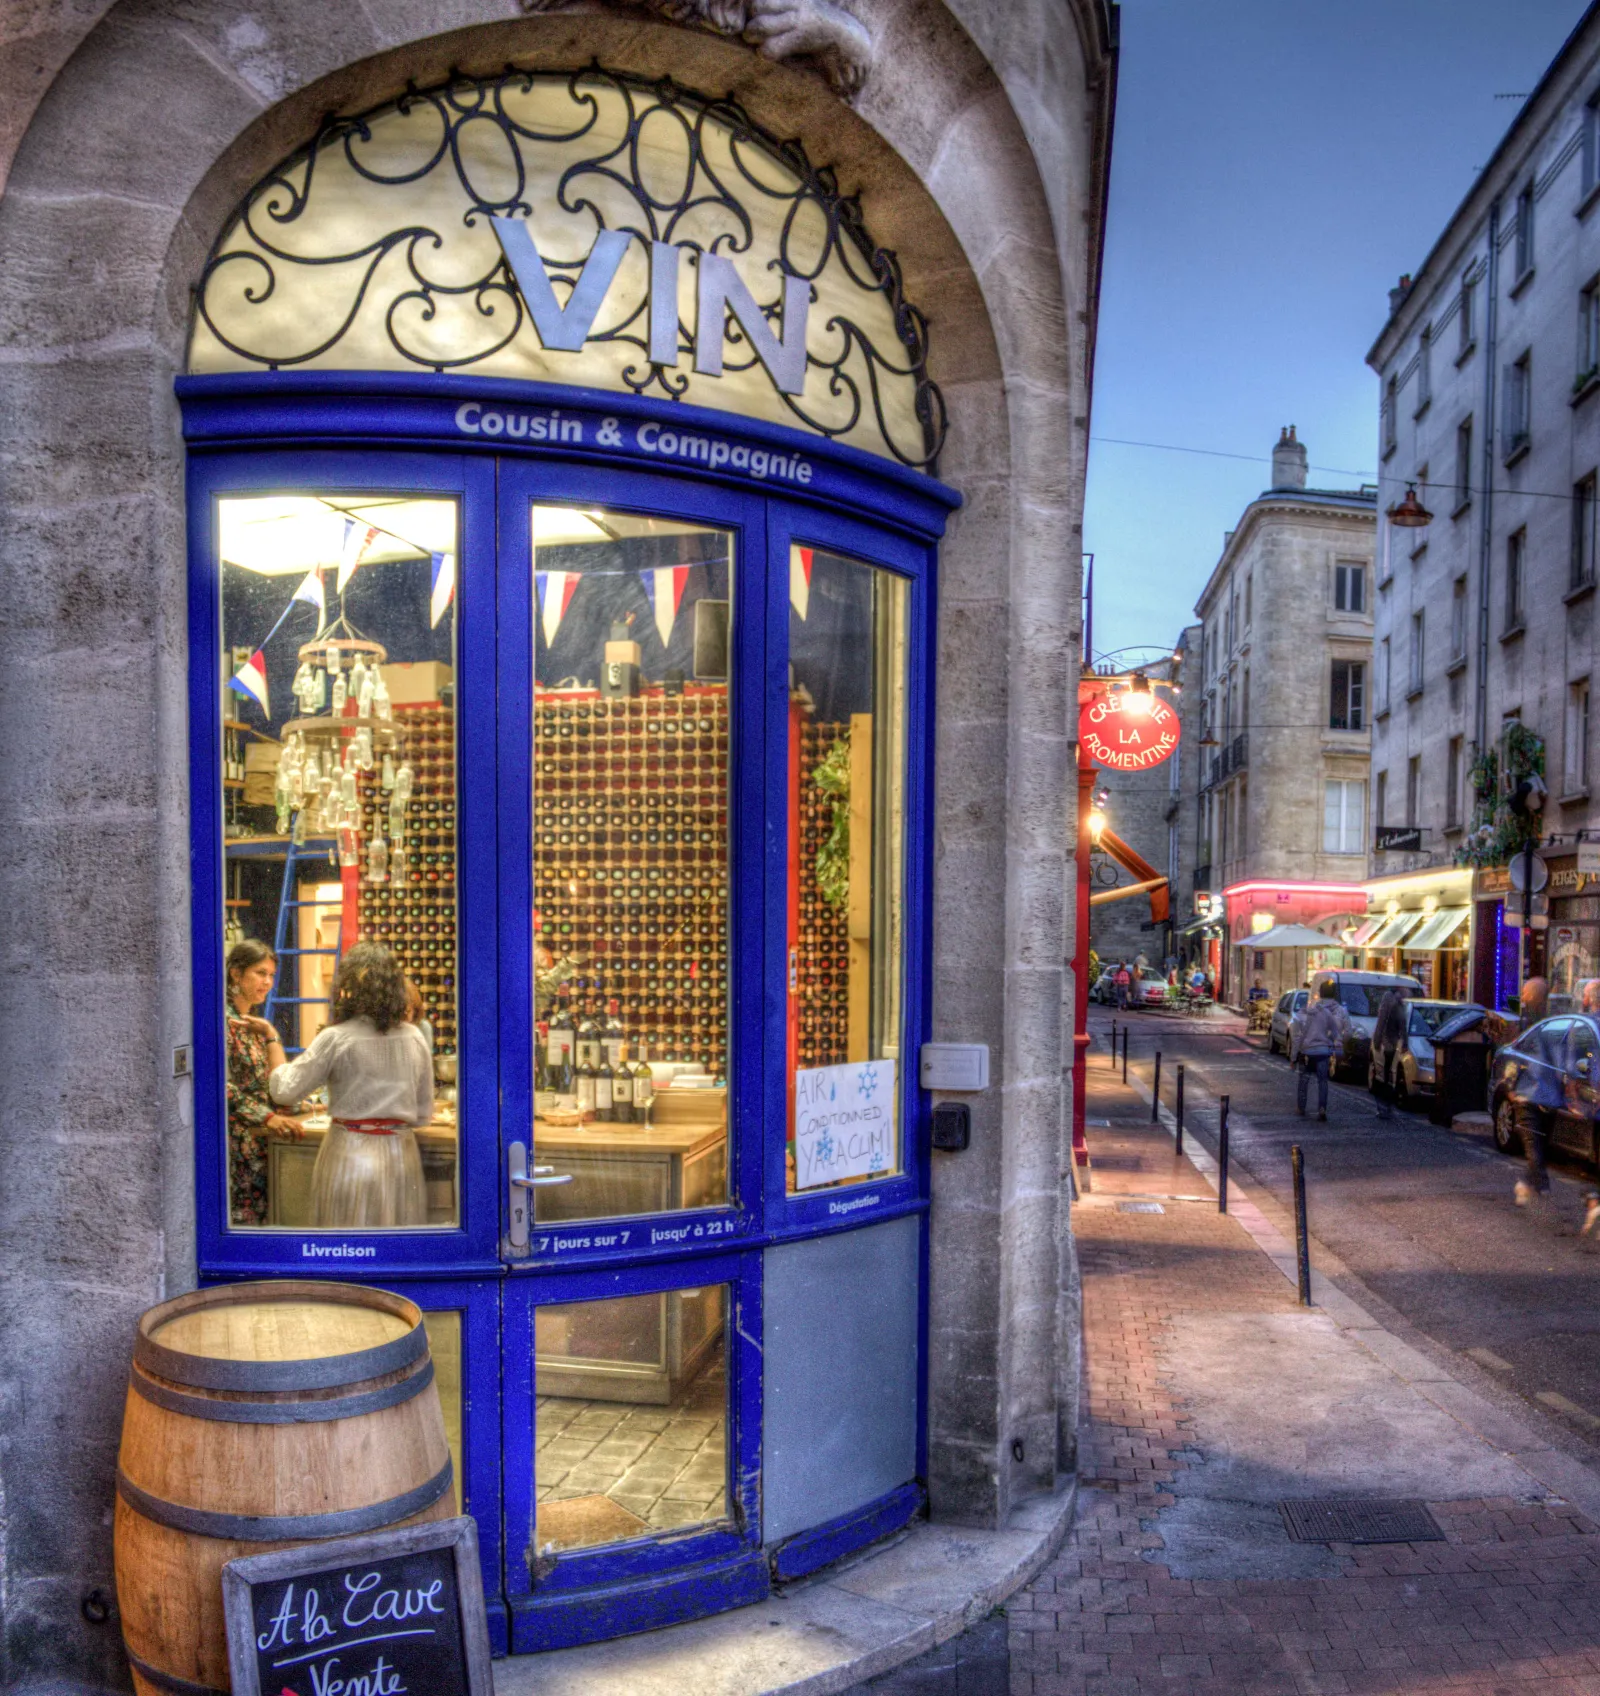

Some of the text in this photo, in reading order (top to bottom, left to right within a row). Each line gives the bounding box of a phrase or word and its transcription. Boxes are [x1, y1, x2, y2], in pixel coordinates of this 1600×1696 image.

[490, 216, 811, 396] VIN
[455, 402, 814, 484] Cousin & Compagnie
[1089, 694, 1171, 725] CRÊIE
[1083, 731, 1176, 767] FROMENTINE
[1119, 729, 1141, 744] LA
[798, 1072, 828, 1106] AIR
[829, 1194, 880, 1215] Dégustation
[302, 1243, 376, 1257] Livraison
[540, 1238, 549, 1251] 7
[553, 1237, 591, 1253] jours
[594, 1236, 617, 1246] sur
[621, 1232, 630, 1245] 7
[694, 1223, 703, 1237] à
[708, 1221, 723, 1235] 22
[725, 1220, 734, 1233] h
[257, 1571, 445, 1650] A la Cave
[309, 1655, 408, 1696] Vente
